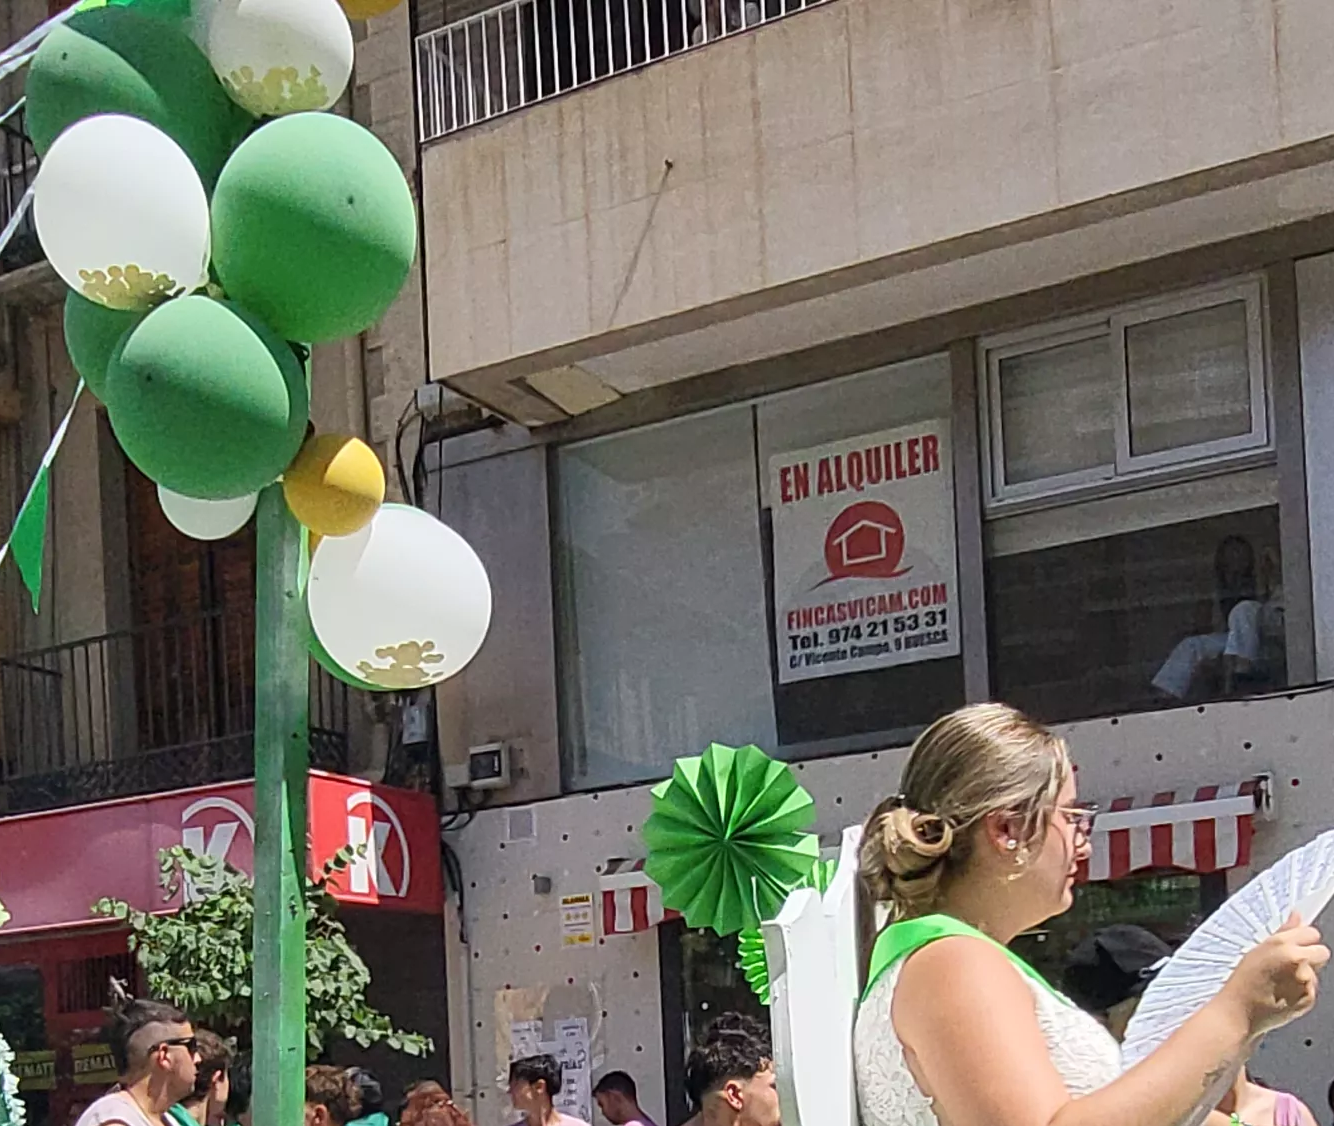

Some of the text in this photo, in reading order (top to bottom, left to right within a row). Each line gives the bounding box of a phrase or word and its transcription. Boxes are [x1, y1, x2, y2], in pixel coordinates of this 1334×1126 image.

[779, 433, 940, 505] EN ALQUILER
[786, 583, 947, 631] FINCASVICAM.COM
[788, 608, 947, 652] Tel. 974 21 53 31
[347, 815, 399, 898] K
